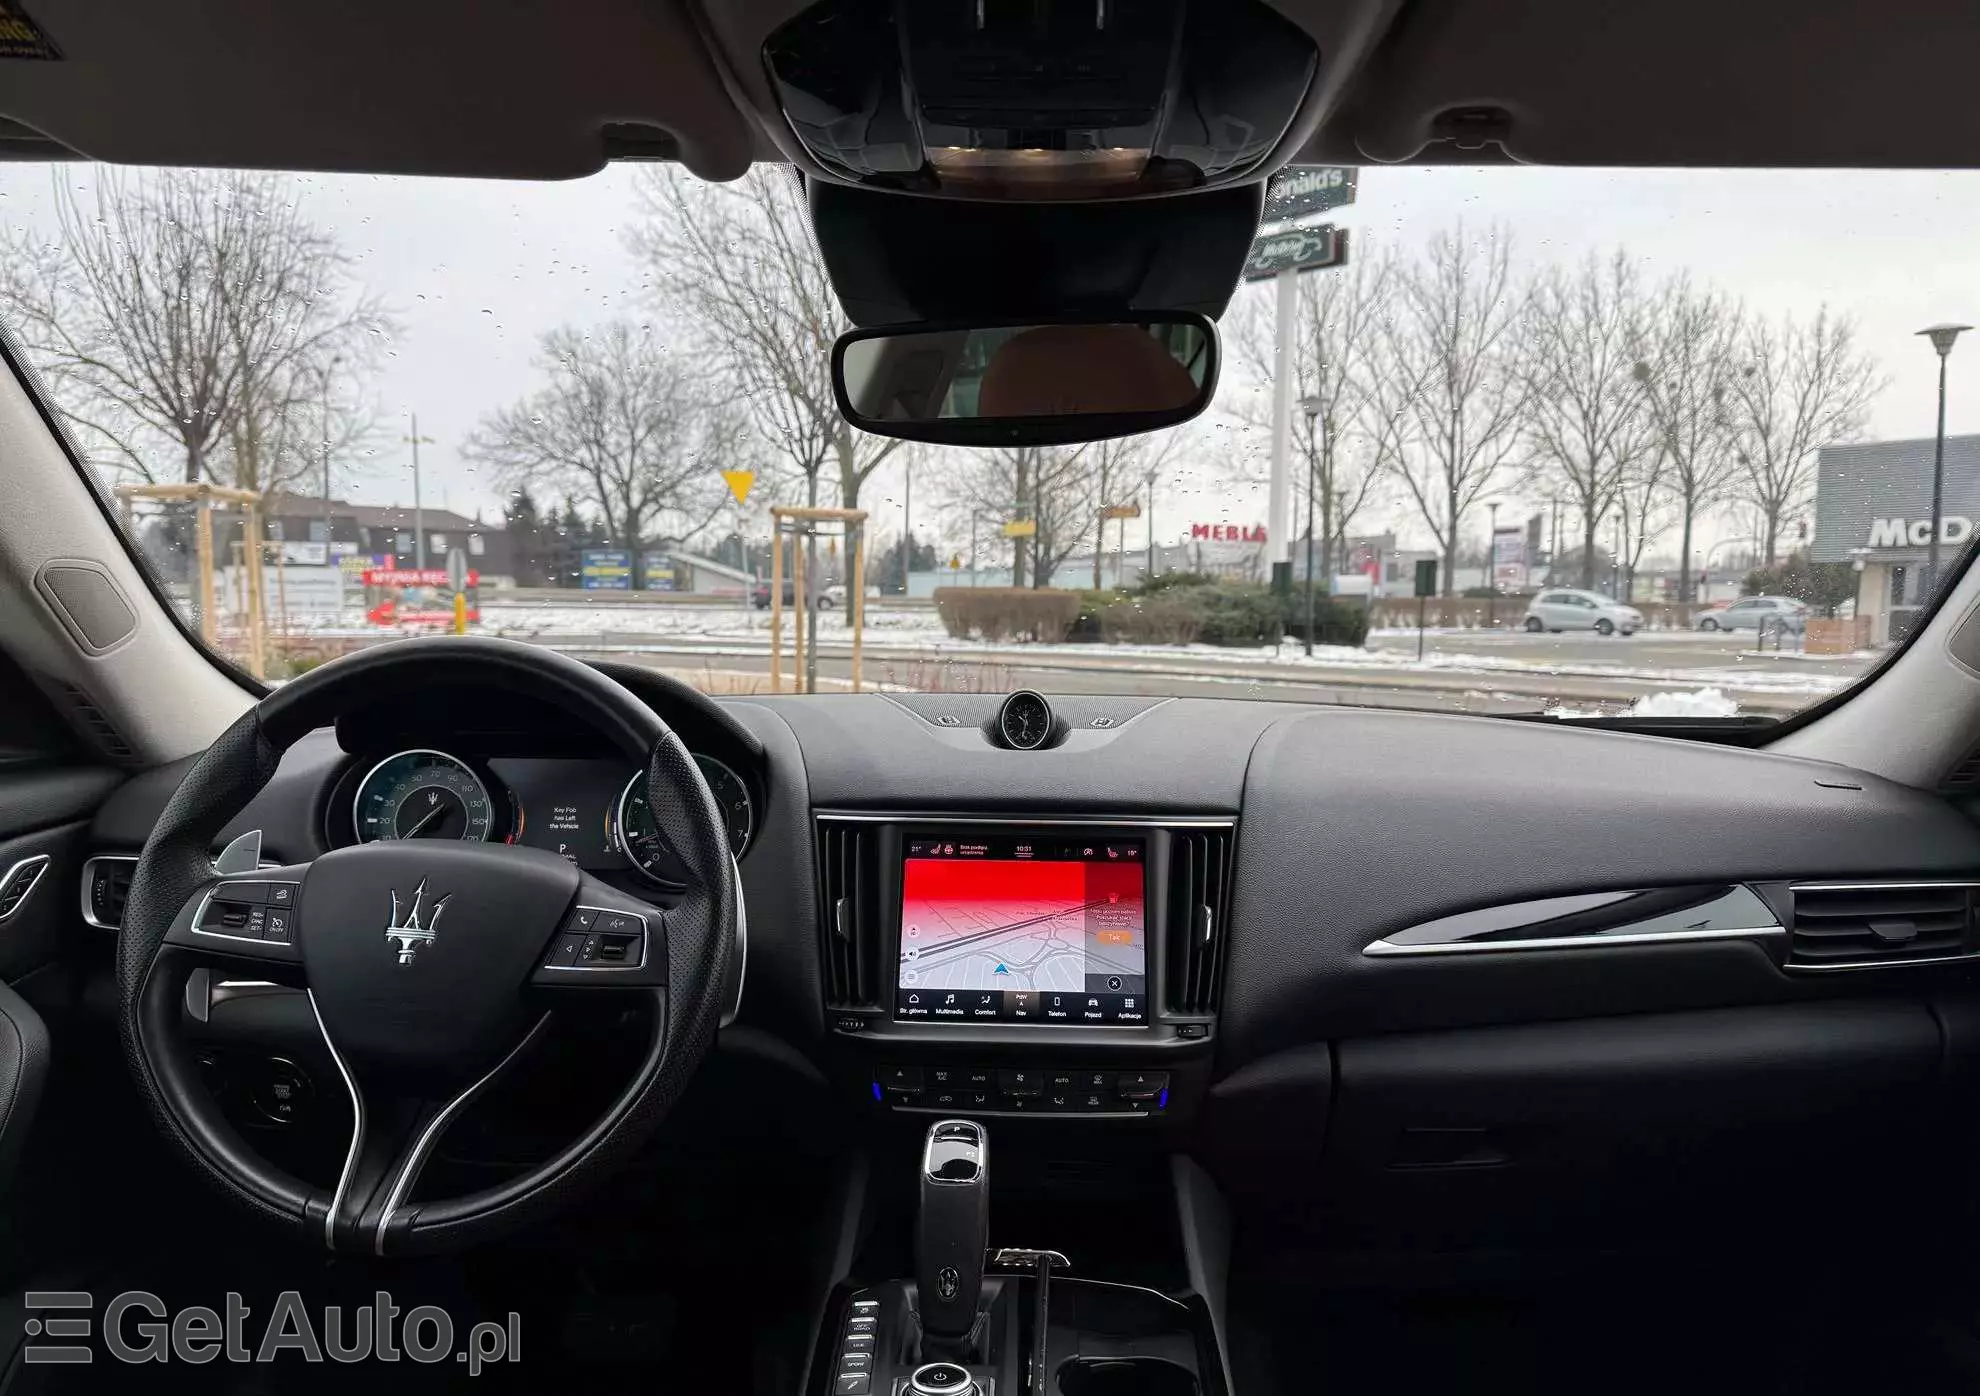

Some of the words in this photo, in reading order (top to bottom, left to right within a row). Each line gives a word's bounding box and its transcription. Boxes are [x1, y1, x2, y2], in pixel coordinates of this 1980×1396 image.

[735, 802, 742, 810] 6
[560, 843, 567, 854] P
[975, 1008, 996, 1016] Comfort
[1048, 1010, 1067, 1018] Telefon
[1084, 1011, 1102, 1019] Pojazd
[1118, 1012, 1142, 1020] Aplikacje
